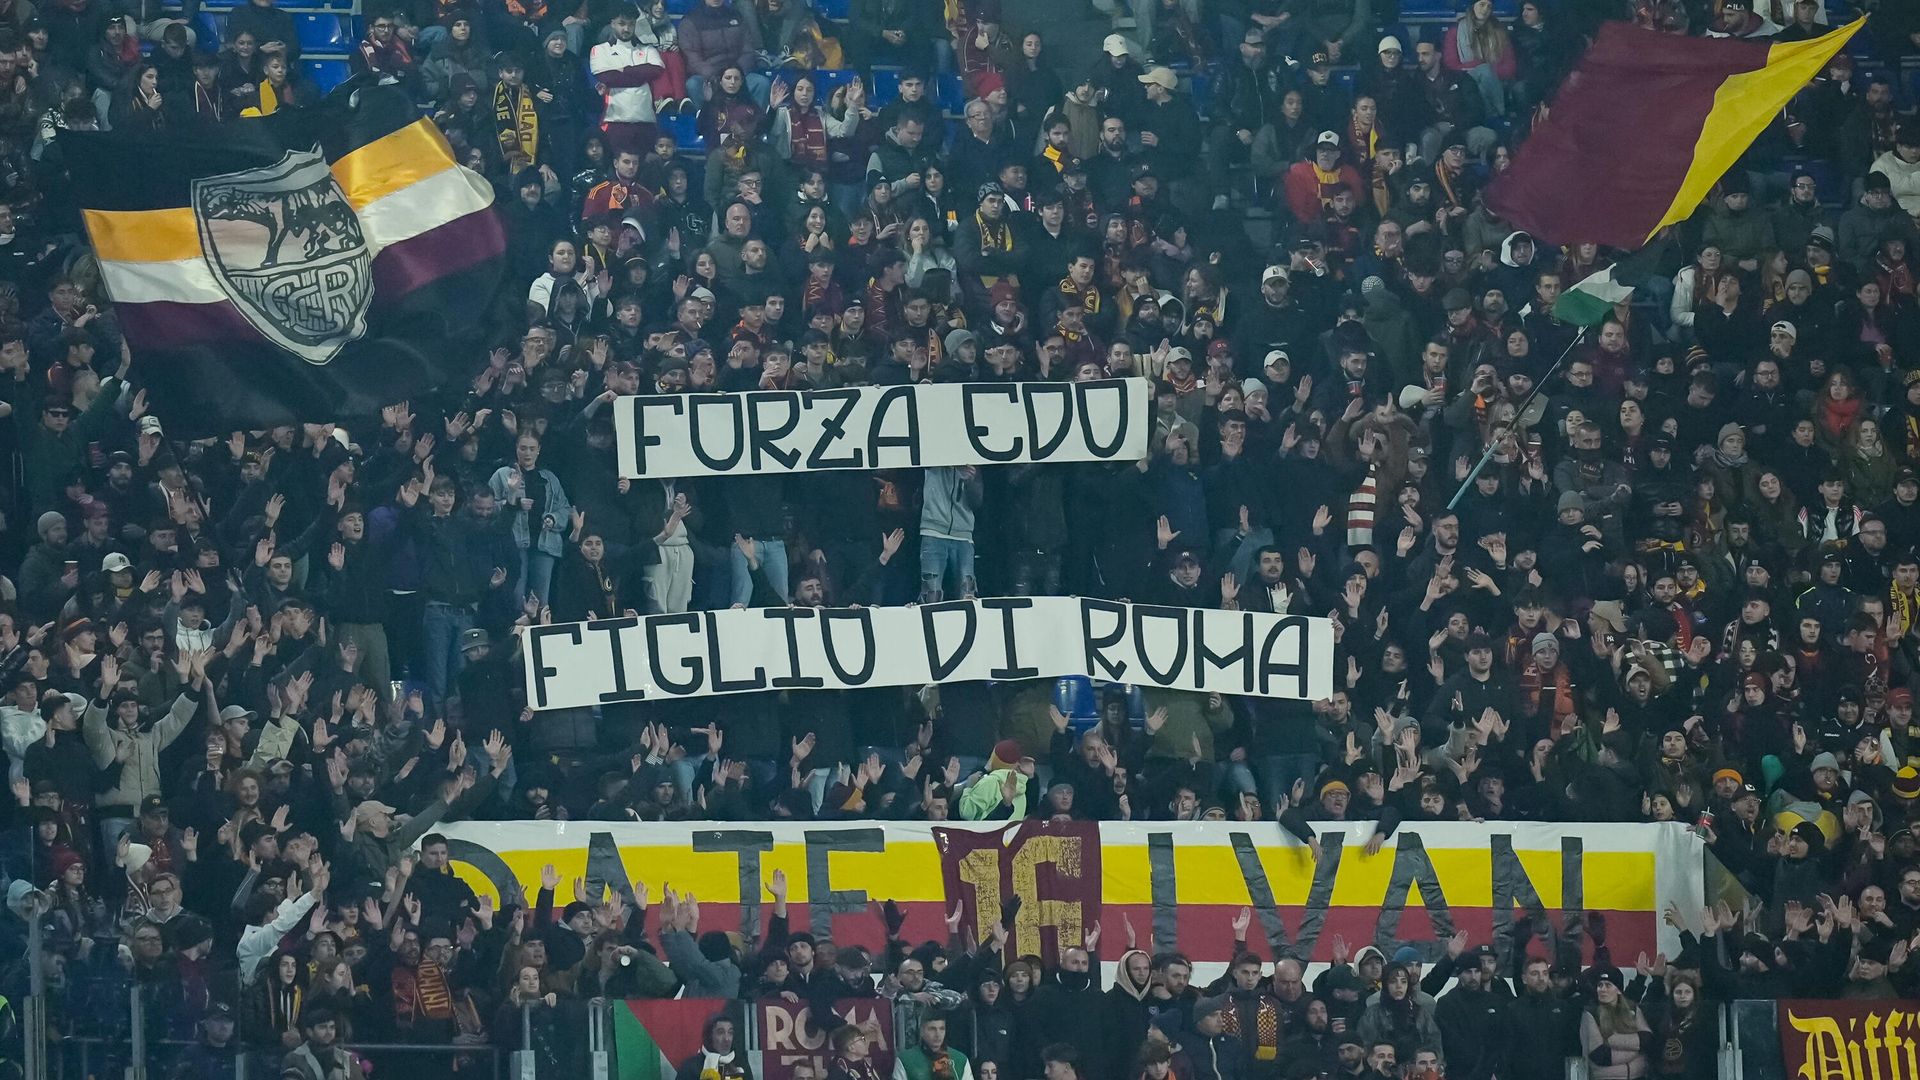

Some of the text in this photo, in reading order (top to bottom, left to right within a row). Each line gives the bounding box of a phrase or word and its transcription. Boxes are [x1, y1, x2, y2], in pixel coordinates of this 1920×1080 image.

[633, 378, 1129, 475] FORZA EDO
[529, 598, 1308, 708] FIGLIO DI ROMA
[1148, 832, 1583, 974] IVAN
[1788, 1008, 1920, 1080] Diffi
